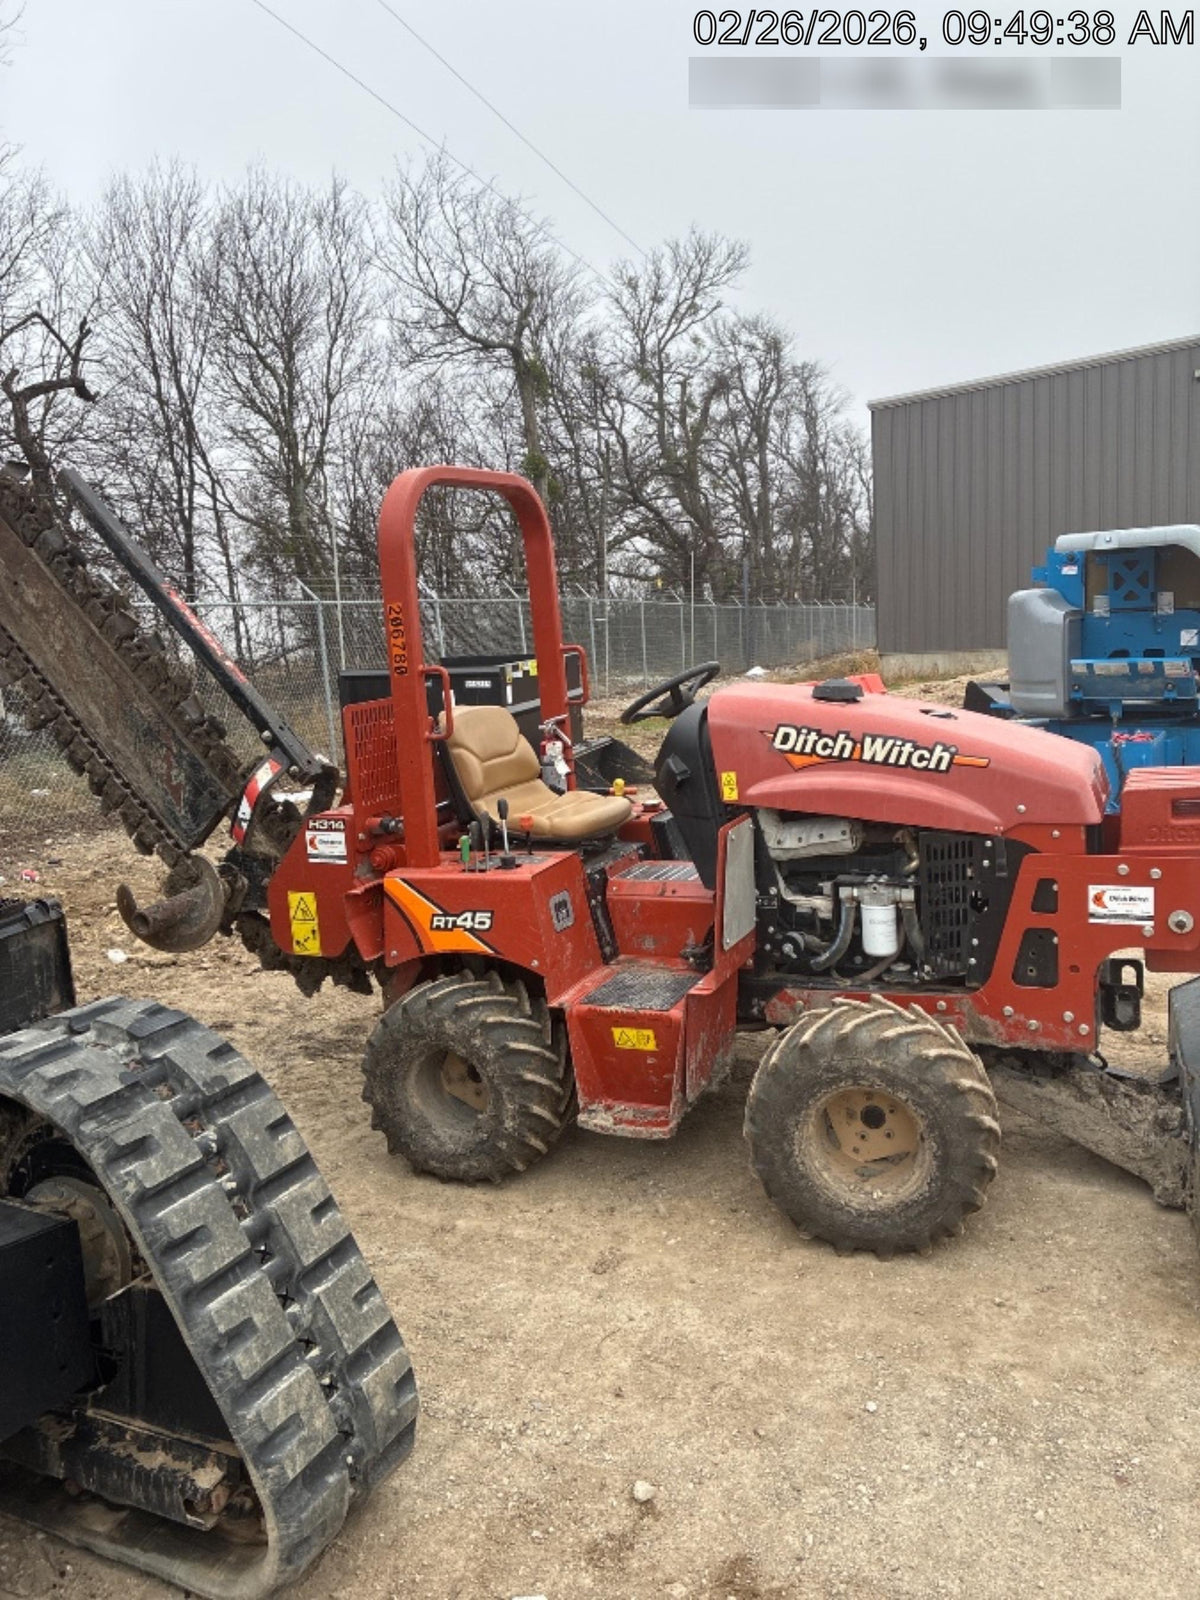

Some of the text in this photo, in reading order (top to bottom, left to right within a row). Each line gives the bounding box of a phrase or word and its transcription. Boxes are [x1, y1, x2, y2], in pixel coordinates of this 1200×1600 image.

[388, 603, 408, 675] 206780
[773, 725, 953, 772] Ditch Witch
[308, 819, 345, 831] H314
[431, 911, 493, 930] RT45
